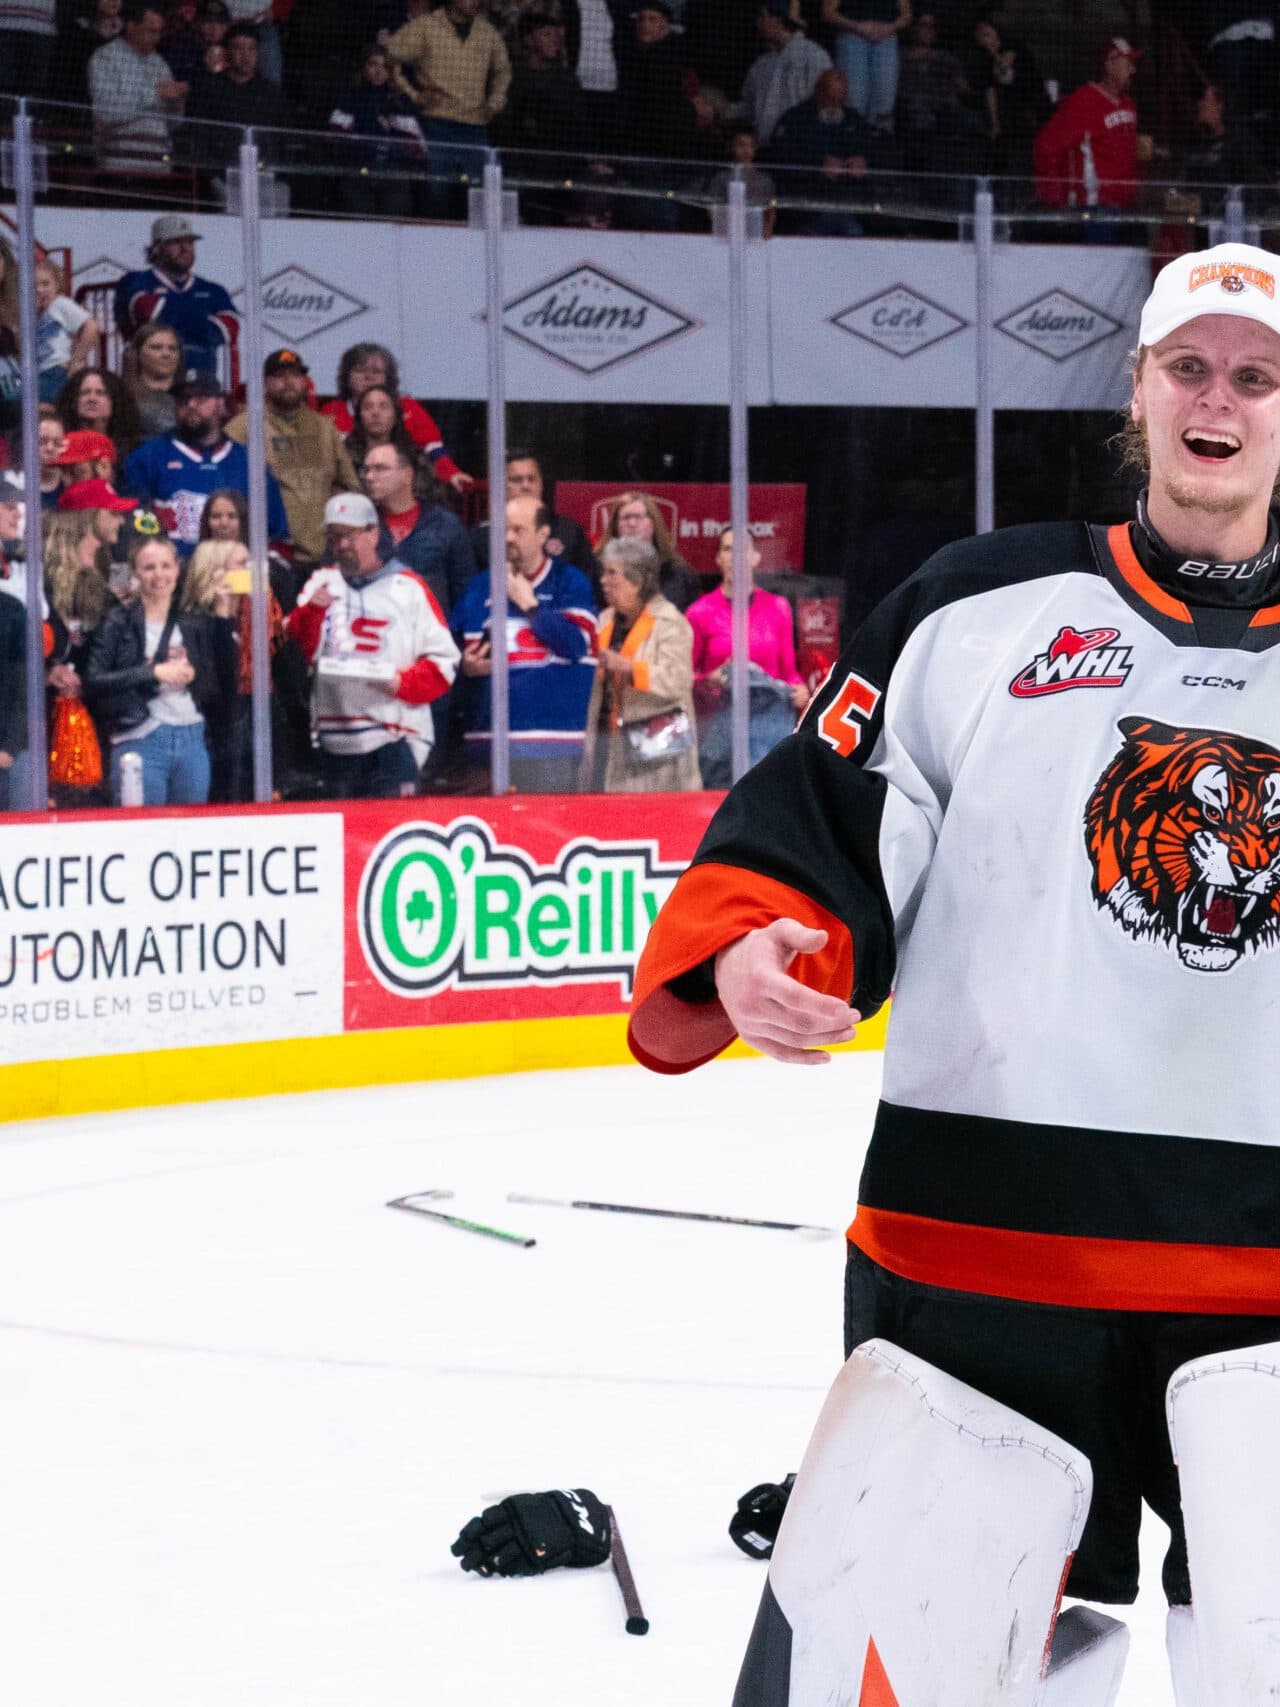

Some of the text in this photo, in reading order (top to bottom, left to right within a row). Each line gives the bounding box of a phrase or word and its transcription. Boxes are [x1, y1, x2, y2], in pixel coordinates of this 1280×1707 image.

[522, 294, 649, 330] Adams
[1016, 309, 1096, 332] Adams
[1033, 645, 1134, 687] WHL
[1181, 674, 1247, 691] CCM
[149, 845, 320, 901] OFFICE
[147, 984, 267, 1014] SOLVED
